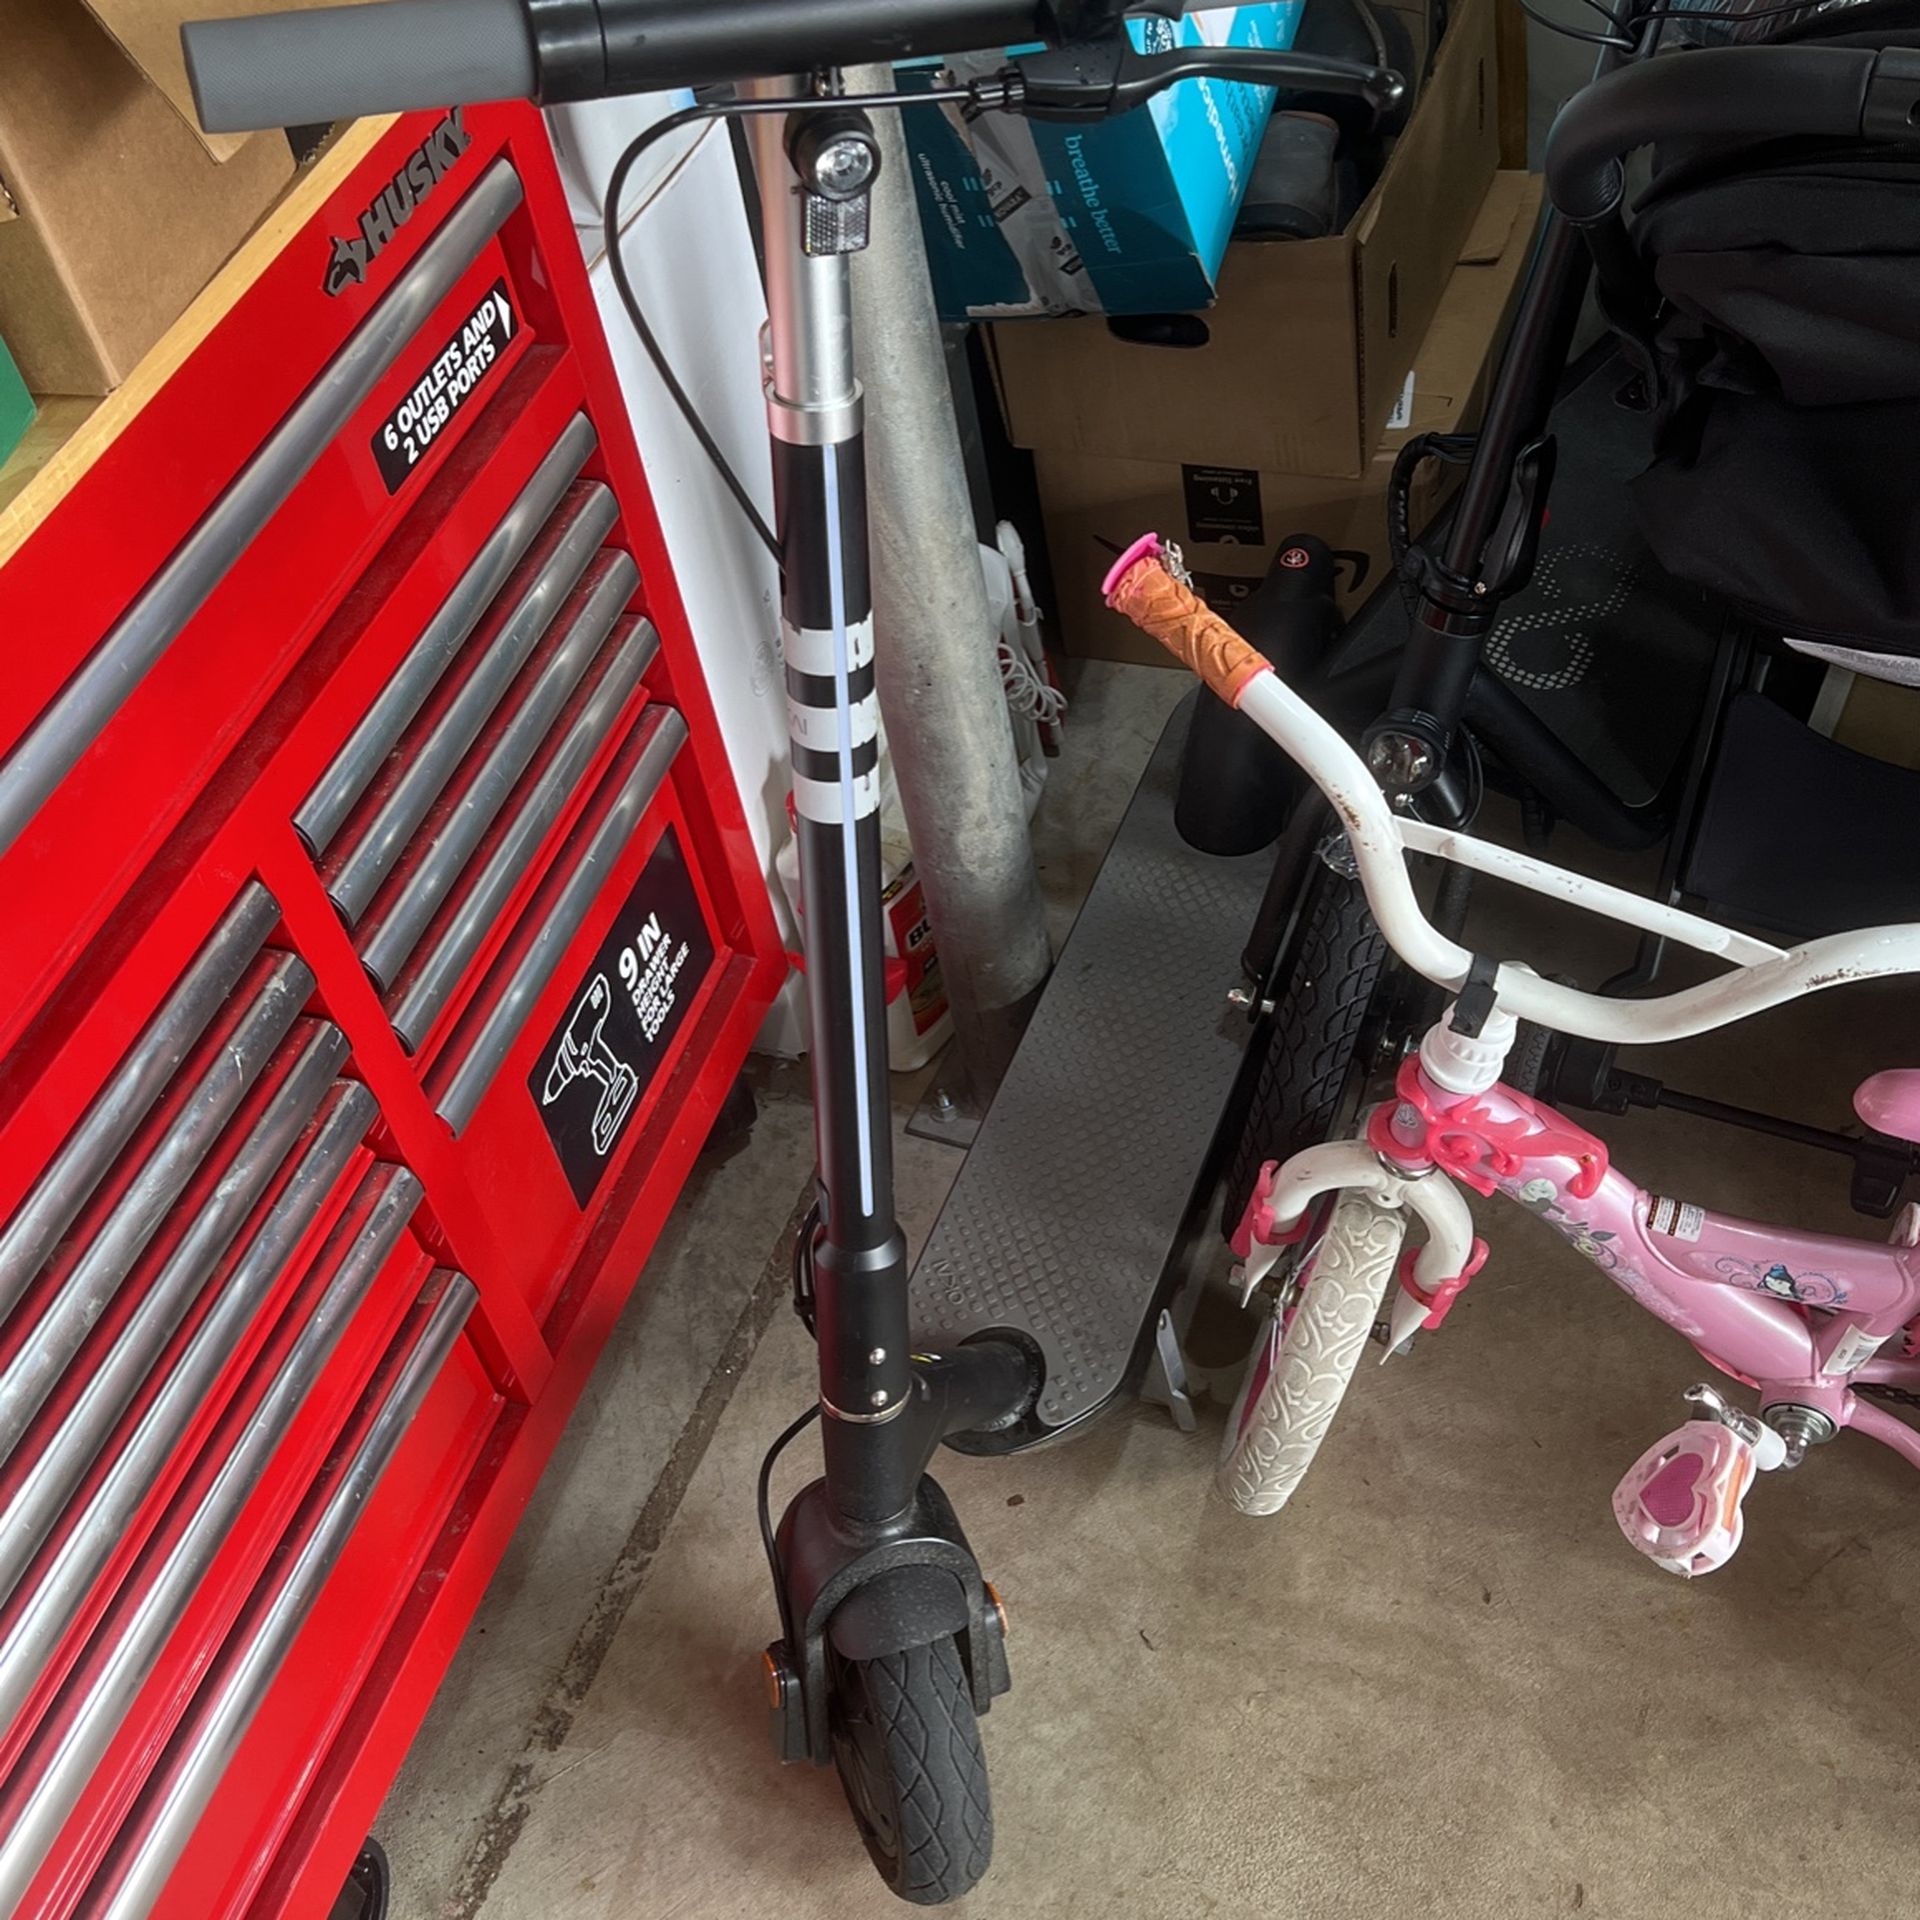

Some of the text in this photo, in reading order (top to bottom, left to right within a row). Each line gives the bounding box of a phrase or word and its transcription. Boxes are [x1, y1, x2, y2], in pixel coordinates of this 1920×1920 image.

[358, 104, 464, 258] HUSKY
[917, 152, 966, 249] ultrasonic humidifier
[940, 180, 966, 224] cool mist
[1064, 134, 1122, 254] breathe better
[384, 300, 496, 450] 6 OUTLETS AND
[403, 334, 495, 464] 2 USB PORTS
[619, 912, 661, 991] 9 IN
[632, 933, 672, 1006] DRAWER
[636, 956, 669, 1019] HEIGHT
[641, 941, 690, 1031] FOR LARGE
[645, 989, 675, 1042] TOOLS
